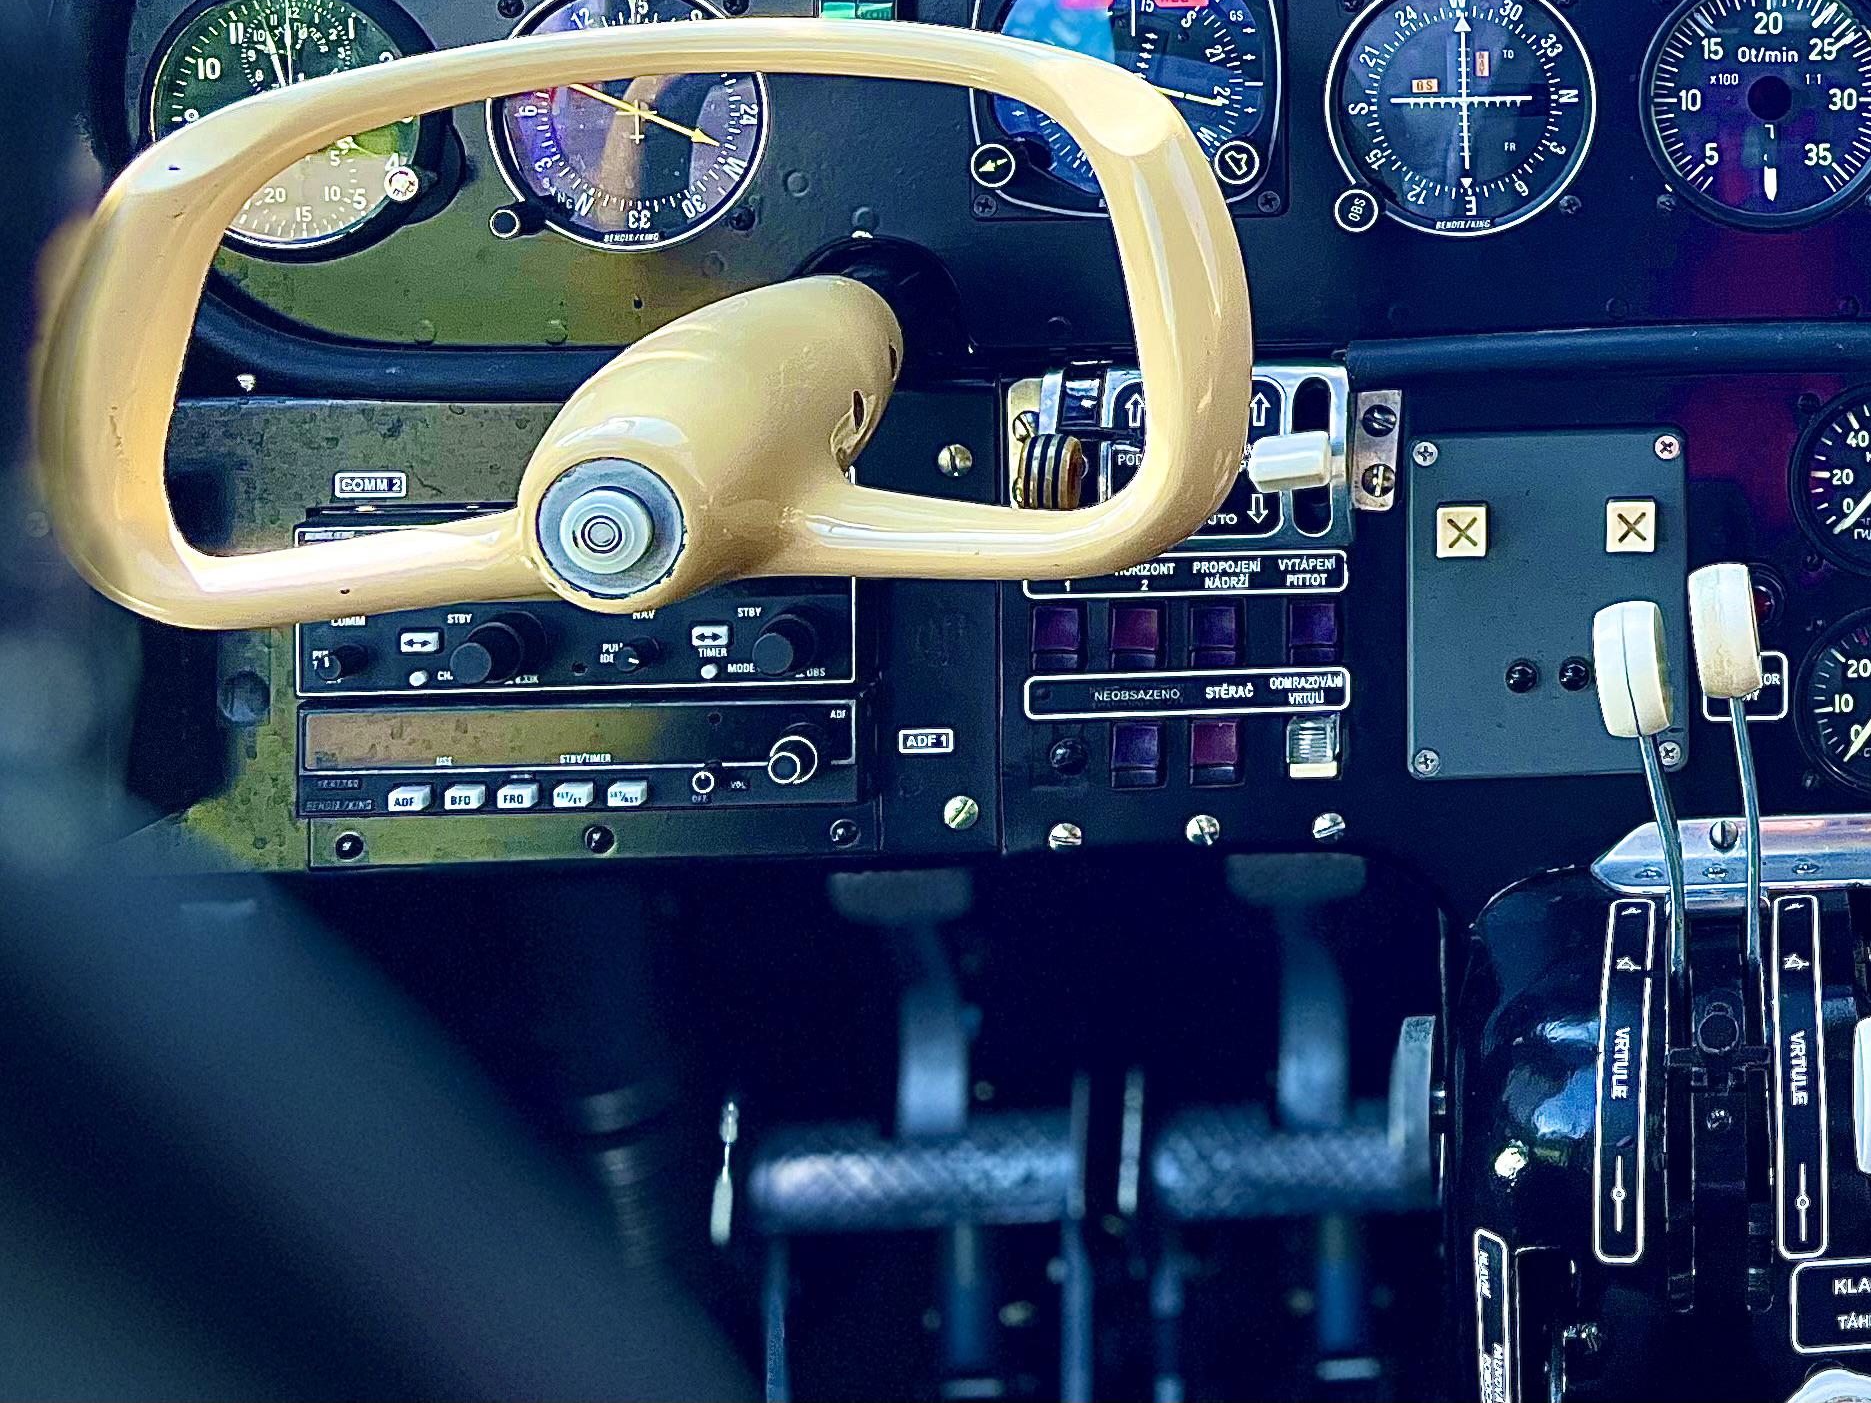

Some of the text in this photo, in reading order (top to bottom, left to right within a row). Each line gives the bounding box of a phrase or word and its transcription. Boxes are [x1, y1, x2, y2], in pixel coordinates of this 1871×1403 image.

[1228, 9, 1244, 22] GS
[1394, 5, 1418, 28] 24
[1753, 11, 1783, 35] 20
[1540, 32, 1564, 58] 33
[1701, 37, 1724, 61] 15
[197, 57, 221, 80] 10
[1678, 88, 1702, 112] 10
[1828, 87, 1858, 111] 30
[1503, 141, 1516, 152] FR
[1803, 142, 1834, 167] 35
[340, 476, 402, 494] COMM 2
[1192, 557, 1262, 574] PROPOJENÍ
[446, 613, 473, 624] STBY
[737, 607, 762, 618] STBY
[697, 647, 728, 658] TIMER
[1094, 687, 1182, 702] NEOBSAZENO
[906, 733, 937, 748] ADF
[393, 797, 416, 808] ADF
[1611, 1026, 1632, 1100] VRTULE
[1789, 1030, 1810, 1107] VRTULE
